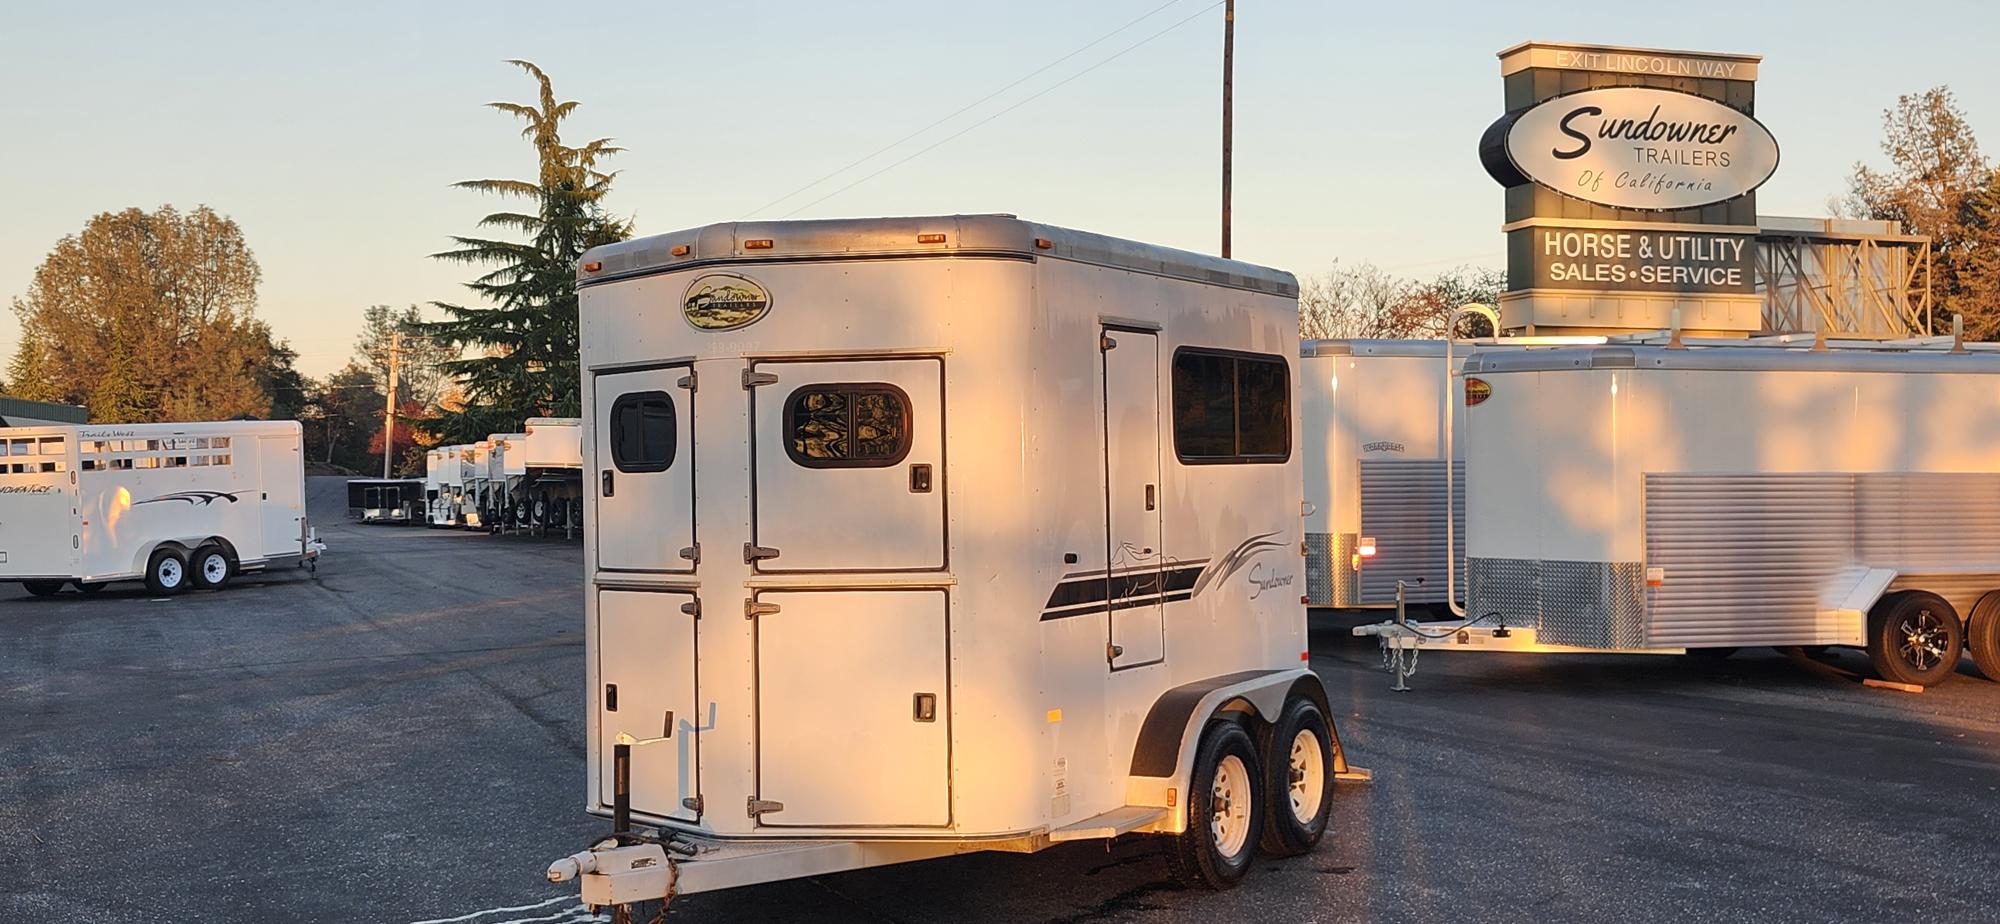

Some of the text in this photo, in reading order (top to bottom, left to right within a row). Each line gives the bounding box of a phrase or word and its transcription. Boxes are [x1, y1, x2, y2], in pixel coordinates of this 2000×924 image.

[1556, 51, 1737, 78] EXIT LINCOLN WAY
[1552, 104, 1738, 160] Sundowner
[1633, 147, 1731, 168] TRAILERS
[1577, 169, 1713, 195] Of California
[1545, 231, 1745, 262] HORSE & UTILITY
[1550, 262, 1742, 286] SALES SERVICE
